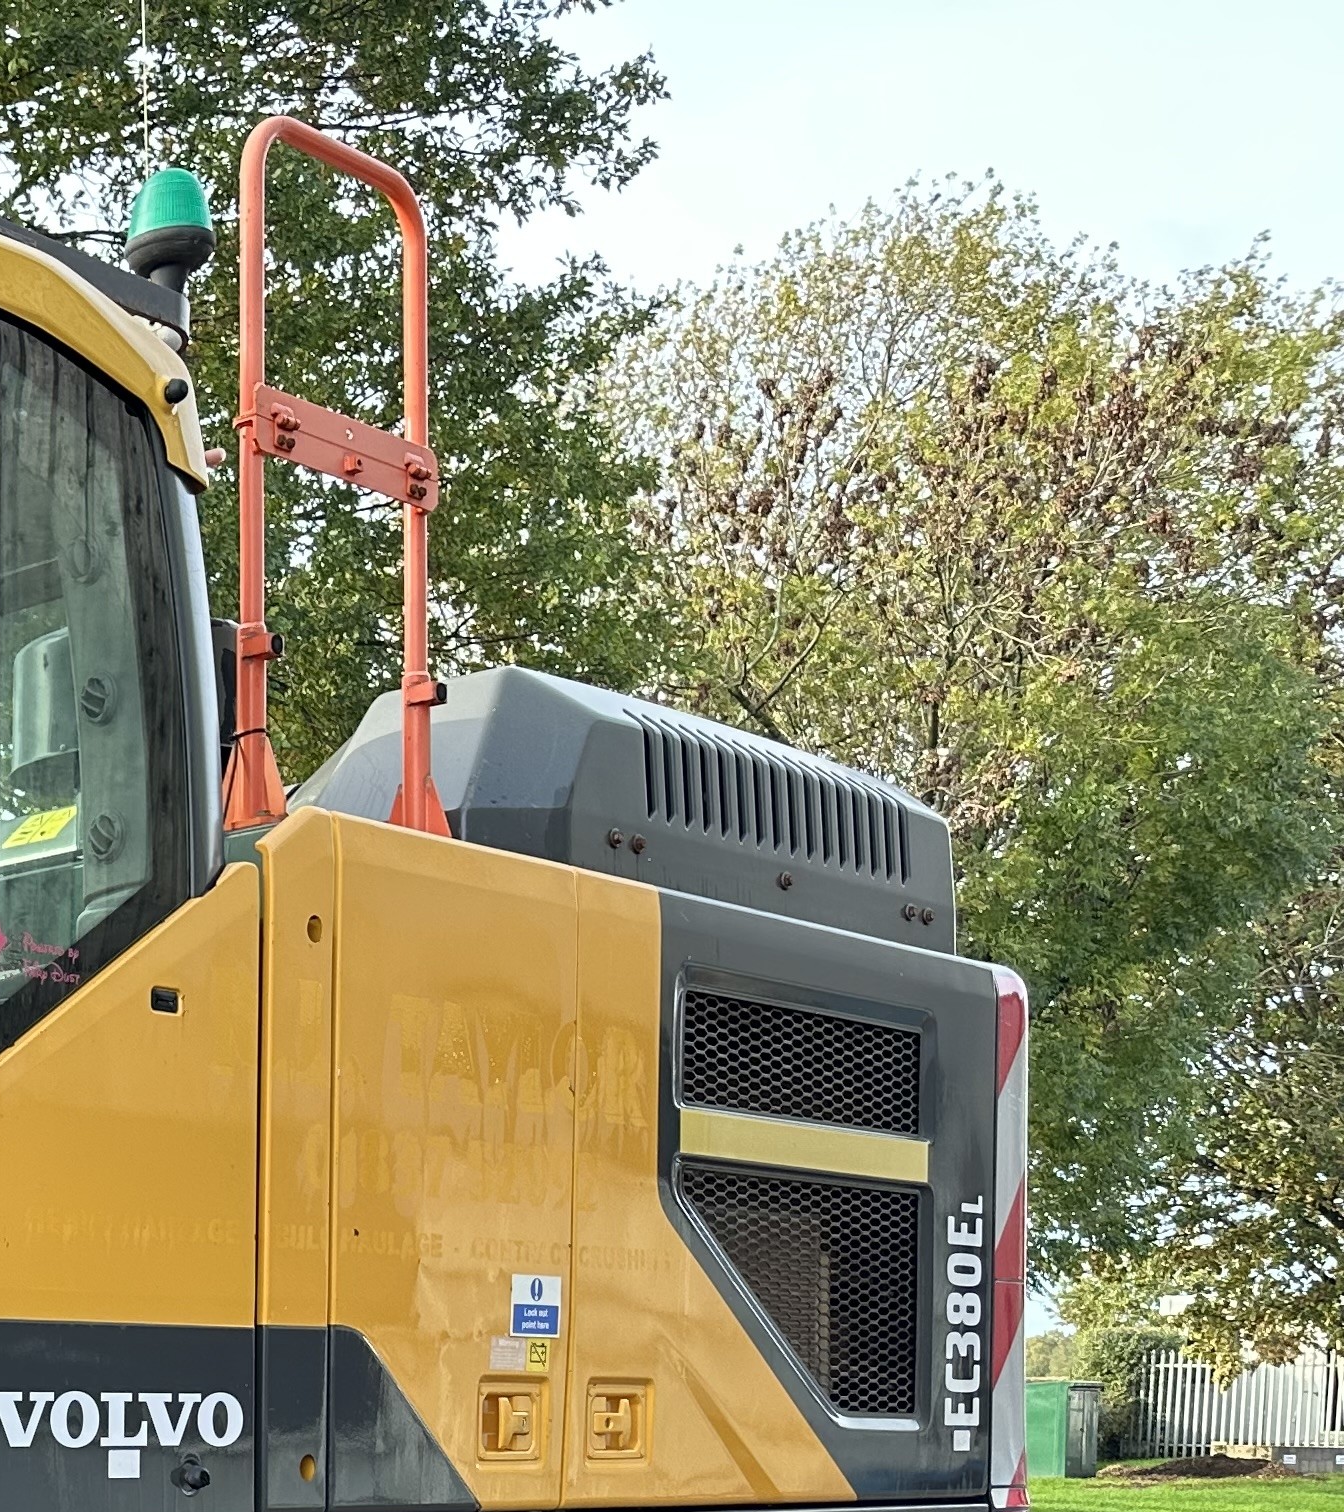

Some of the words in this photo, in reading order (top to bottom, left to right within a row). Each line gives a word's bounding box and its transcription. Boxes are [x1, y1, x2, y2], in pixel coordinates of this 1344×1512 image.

[523, 1308, 537, 1317] Lock
[539, 1309, 549, 1317] out
[522, 1320, 536, 1331] point
[537, 1320, 550, 1329] here
